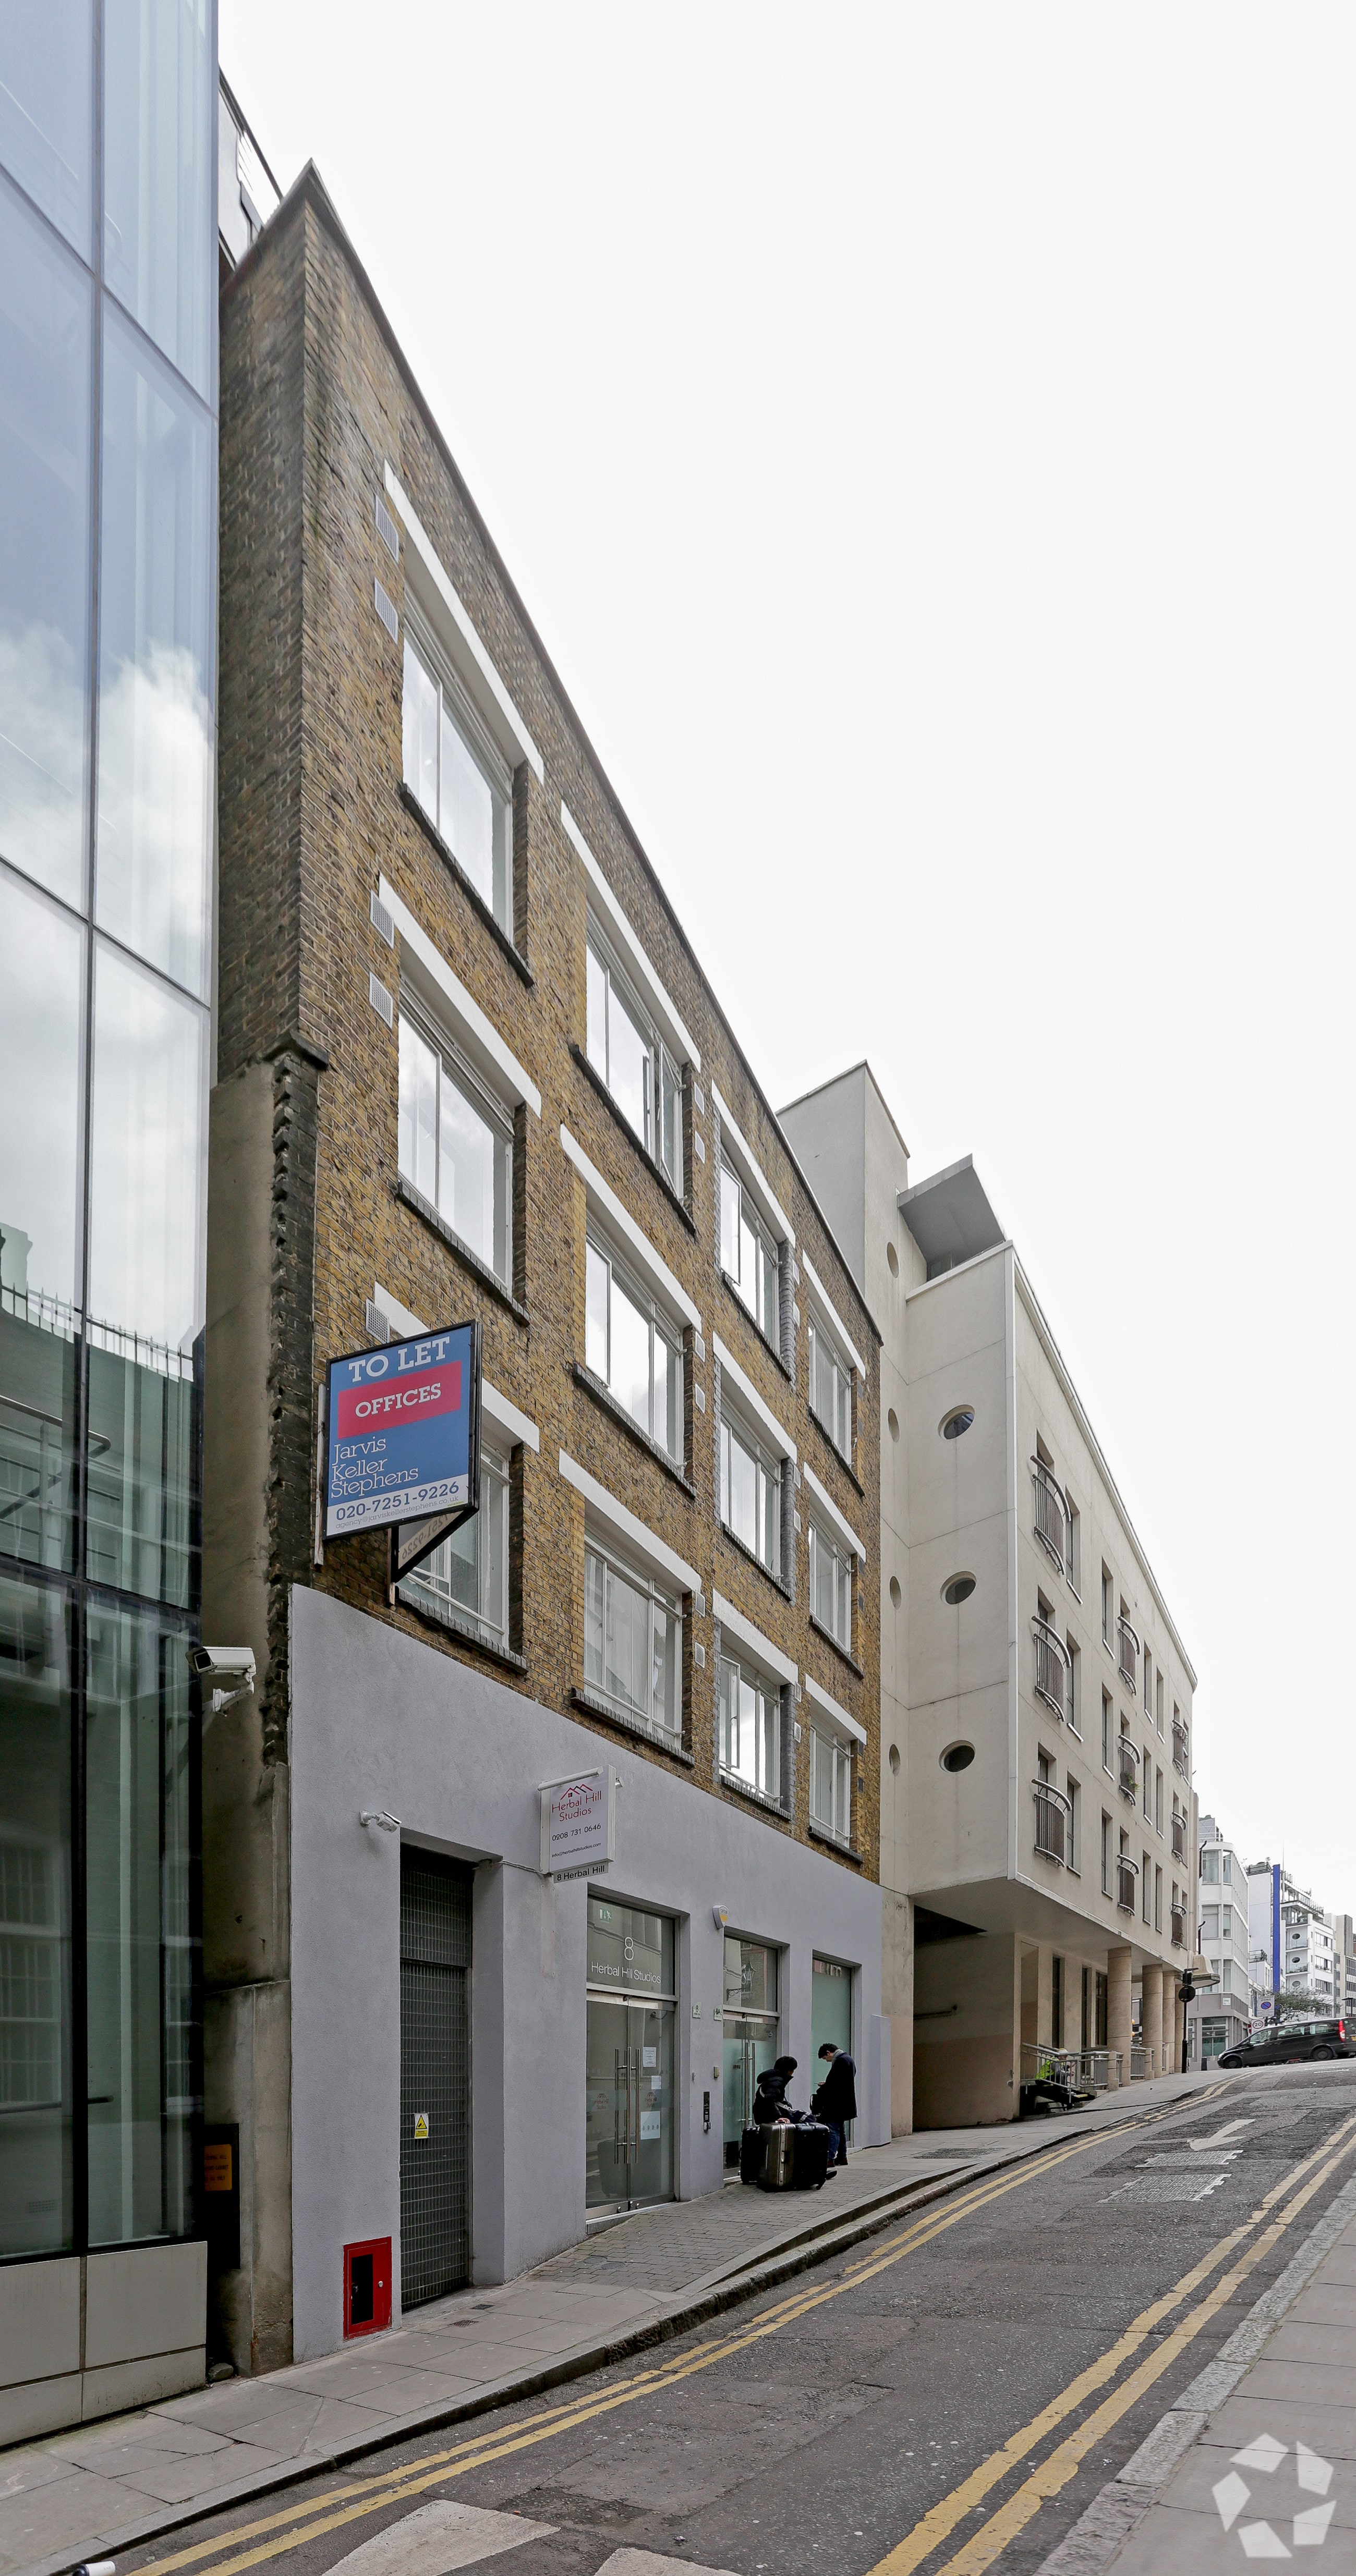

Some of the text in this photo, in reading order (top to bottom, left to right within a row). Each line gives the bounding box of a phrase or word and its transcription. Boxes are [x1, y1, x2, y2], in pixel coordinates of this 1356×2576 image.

[348, 1336, 450, 1383] TO LET
[355, 1383, 442, 1418] OFFICES
[331, 1436, 387, 1466] Jarvis
[331, 1458, 388, 1482] Keller
[331, 1467, 419, 1499] Stephens
[335, 1481, 459, 1521] 020-7251-9226
[335, 1495, 459, 1529] agency@jarviskellerstephens.co.uk
[551, 1790, 602, 1813] Herbal Hill
[559, 1807, 592, 1822] Studios
[551, 1823, 601, 1841] 0208 731 0646
[563, 1868, 589, 1880] Herbal
[592, 1865, 605, 1874] Hill
[624, 1936, 634, 1961] 8
[591, 1961, 661, 1984] Herbal Hill Studios
